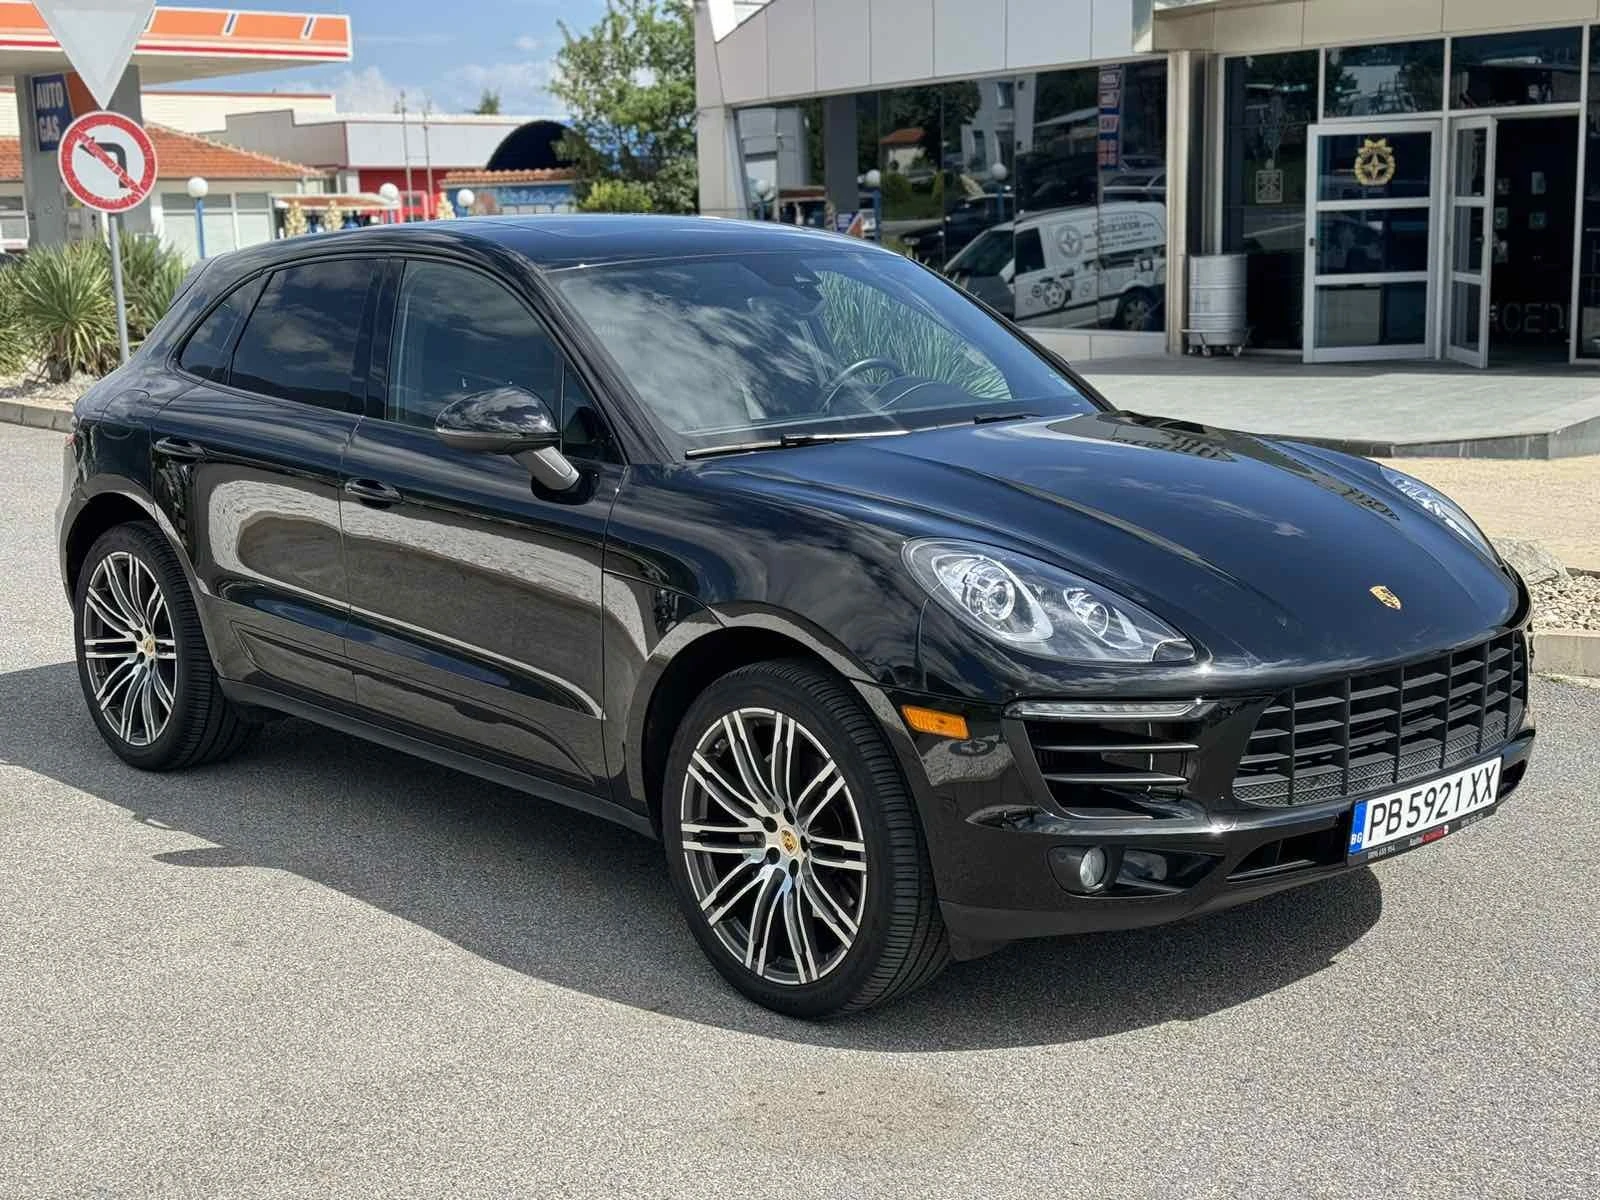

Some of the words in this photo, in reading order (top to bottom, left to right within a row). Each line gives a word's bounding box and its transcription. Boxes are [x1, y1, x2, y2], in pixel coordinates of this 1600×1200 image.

[37, 82, 64, 109] AUTO
[38, 116, 61, 143] GAS
[1351, 832, 1363, 845] BG
